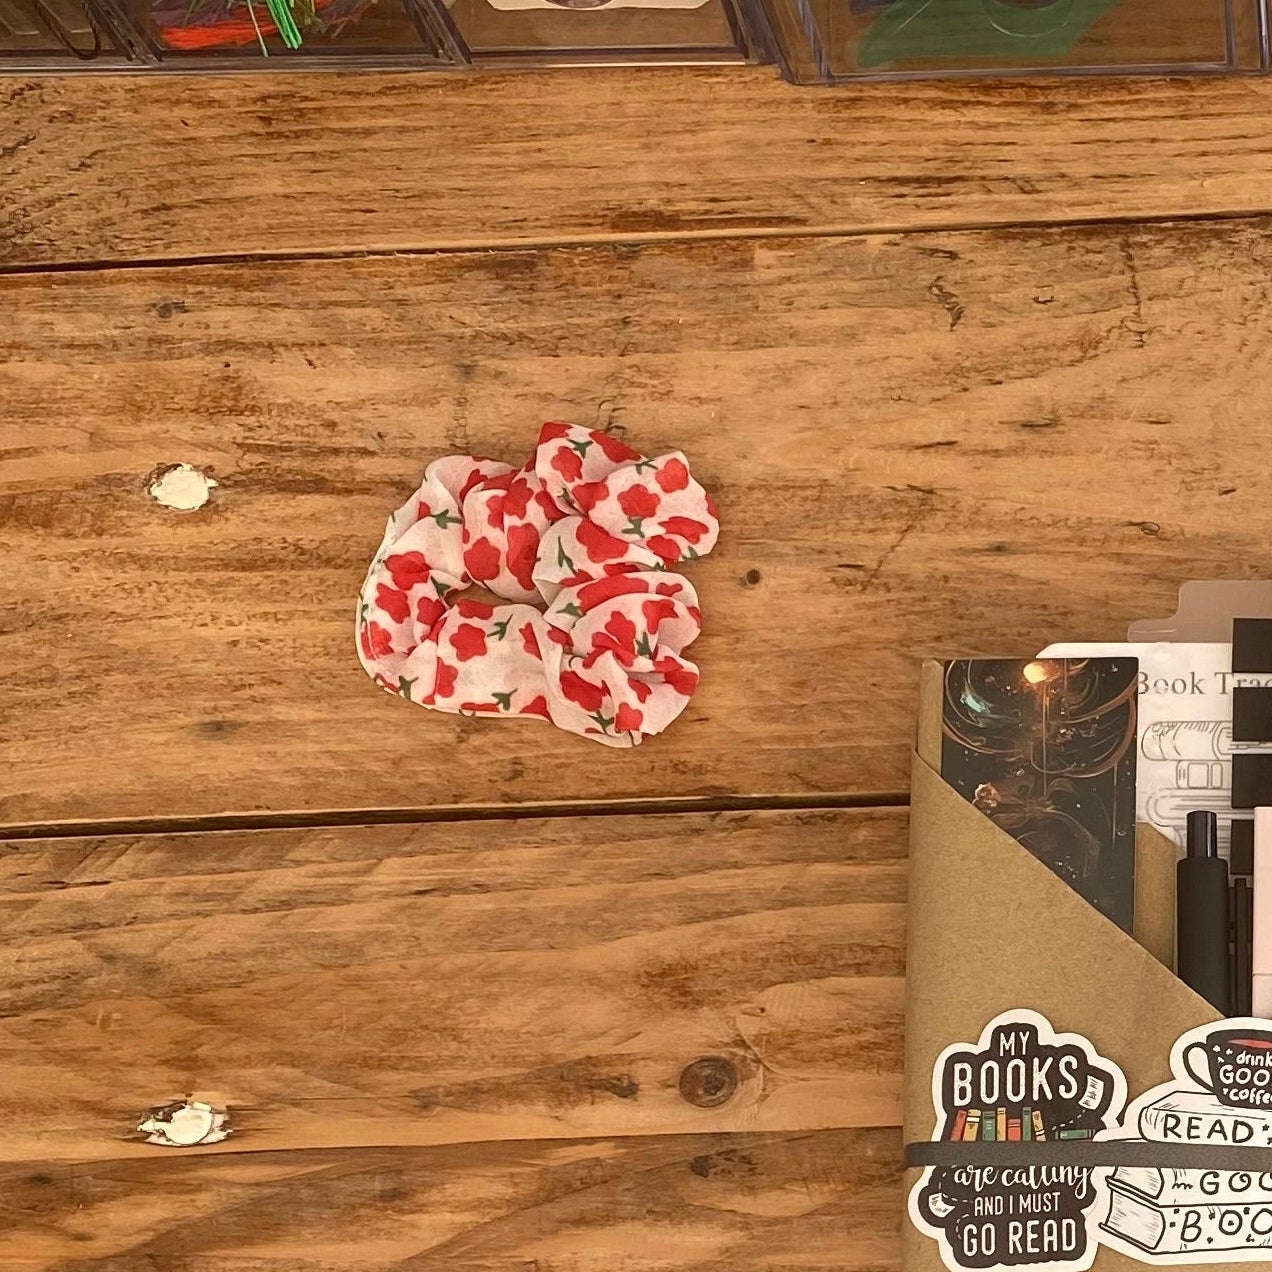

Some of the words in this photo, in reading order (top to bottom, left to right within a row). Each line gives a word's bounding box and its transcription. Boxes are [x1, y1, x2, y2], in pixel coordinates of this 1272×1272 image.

[1137, 671, 1206, 695] Book
[999, 1031, 1030, 1057] MY
[953, 1055, 1078, 1107] BOOKS
[1163, 1113, 1254, 1144] READ
[953, 1164, 999, 1192] are
[974, 1195, 1004, 1217] AND
[1009, 1194, 1014, 1215] I
[1019, 1191, 1061, 1214] MUST
[963, 1223, 996, 1257] GO
[1008, 1218, 1076, 1255] READ
